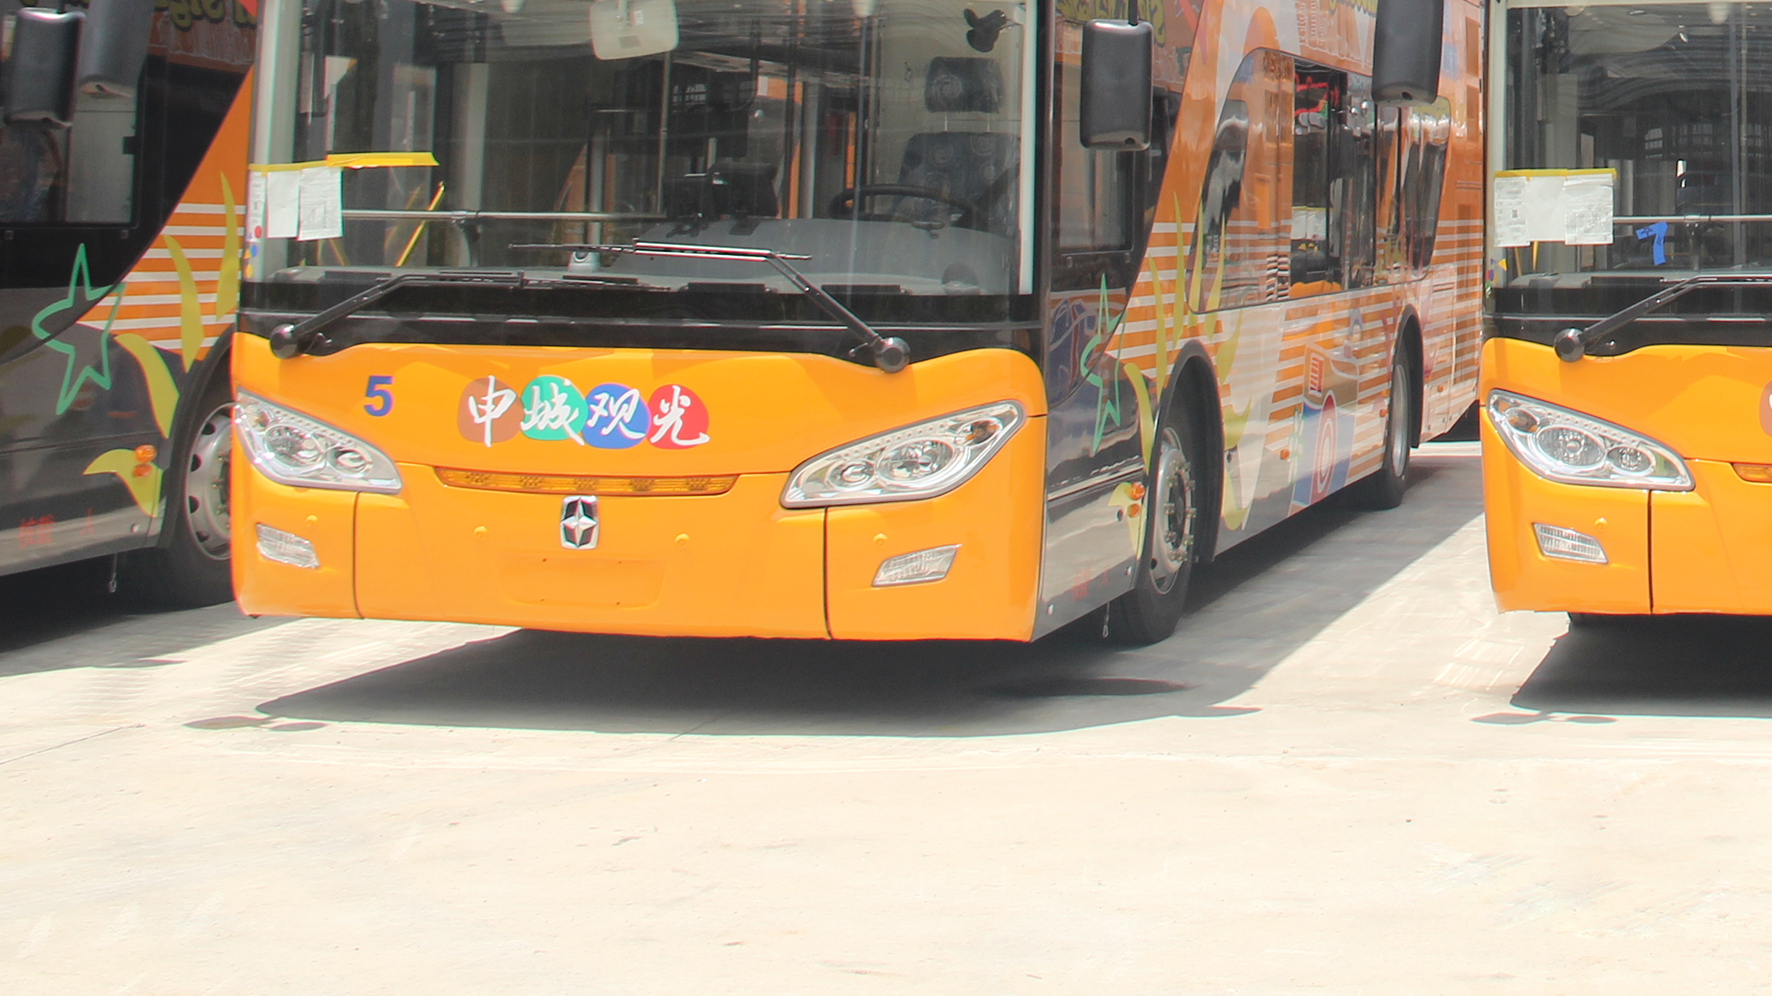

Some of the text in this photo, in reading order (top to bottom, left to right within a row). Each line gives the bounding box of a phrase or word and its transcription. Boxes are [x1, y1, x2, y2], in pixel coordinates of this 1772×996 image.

[1636, 221, 1668, 266] 7
[364, 375, 394, 417] 5
[466, 374, 711, 447] 申城观光
